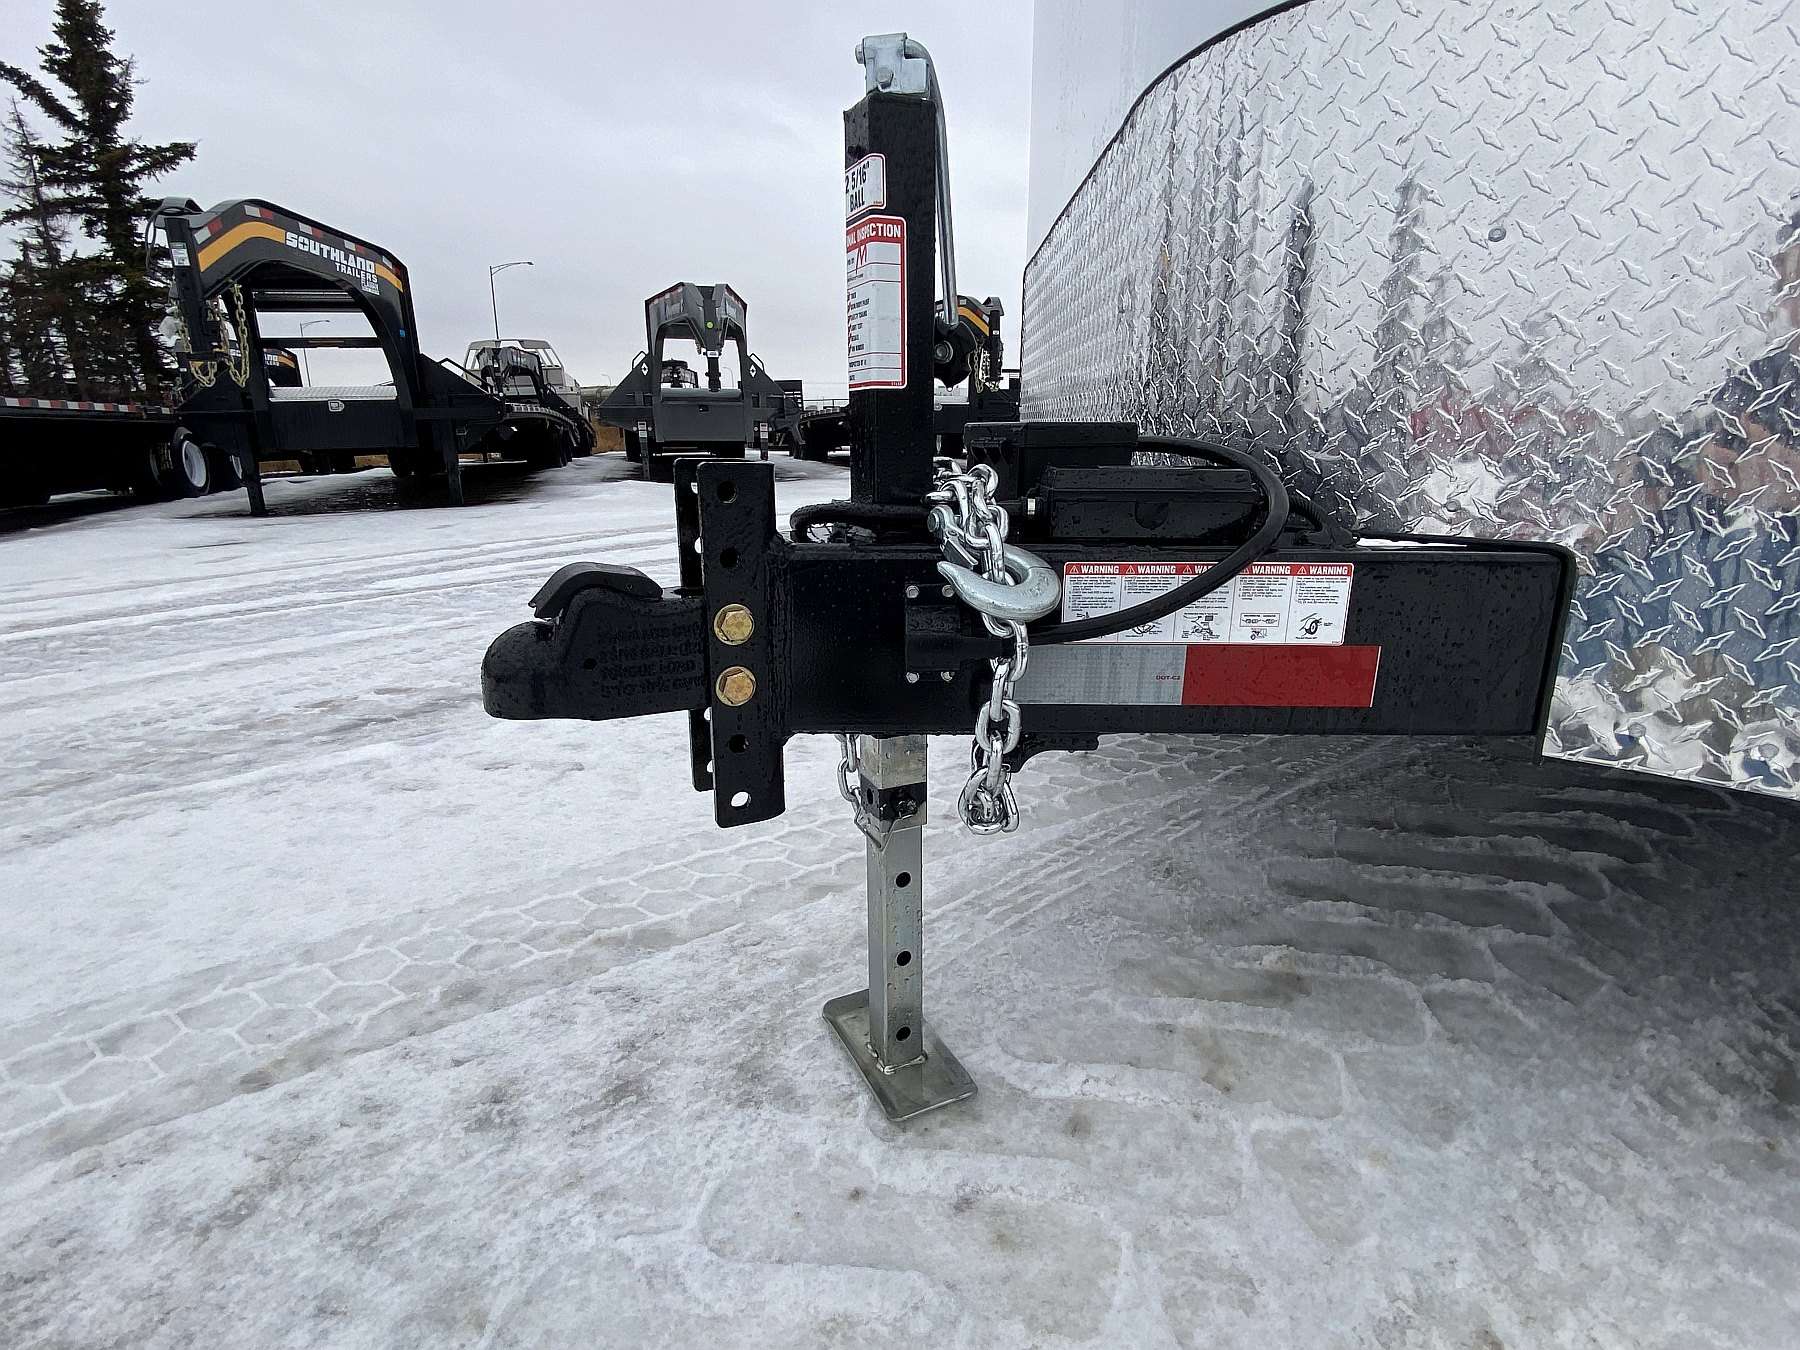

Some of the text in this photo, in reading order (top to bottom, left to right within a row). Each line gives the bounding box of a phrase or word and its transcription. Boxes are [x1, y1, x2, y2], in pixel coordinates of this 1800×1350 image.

[845, 174, 850, 194] 2
[850, 187, 865, 212] BALL
[286, 231, 375, 274] SOUTHLAND
[335, 262, 378, 283] TRAILERS
[1081, 565, 1119, 574] WARNING
[1137, 565, 1176, 574] WARNING
[1252, 565, 1291, 574] WARNING
[1309, 566, 1348, 575] WARNING
